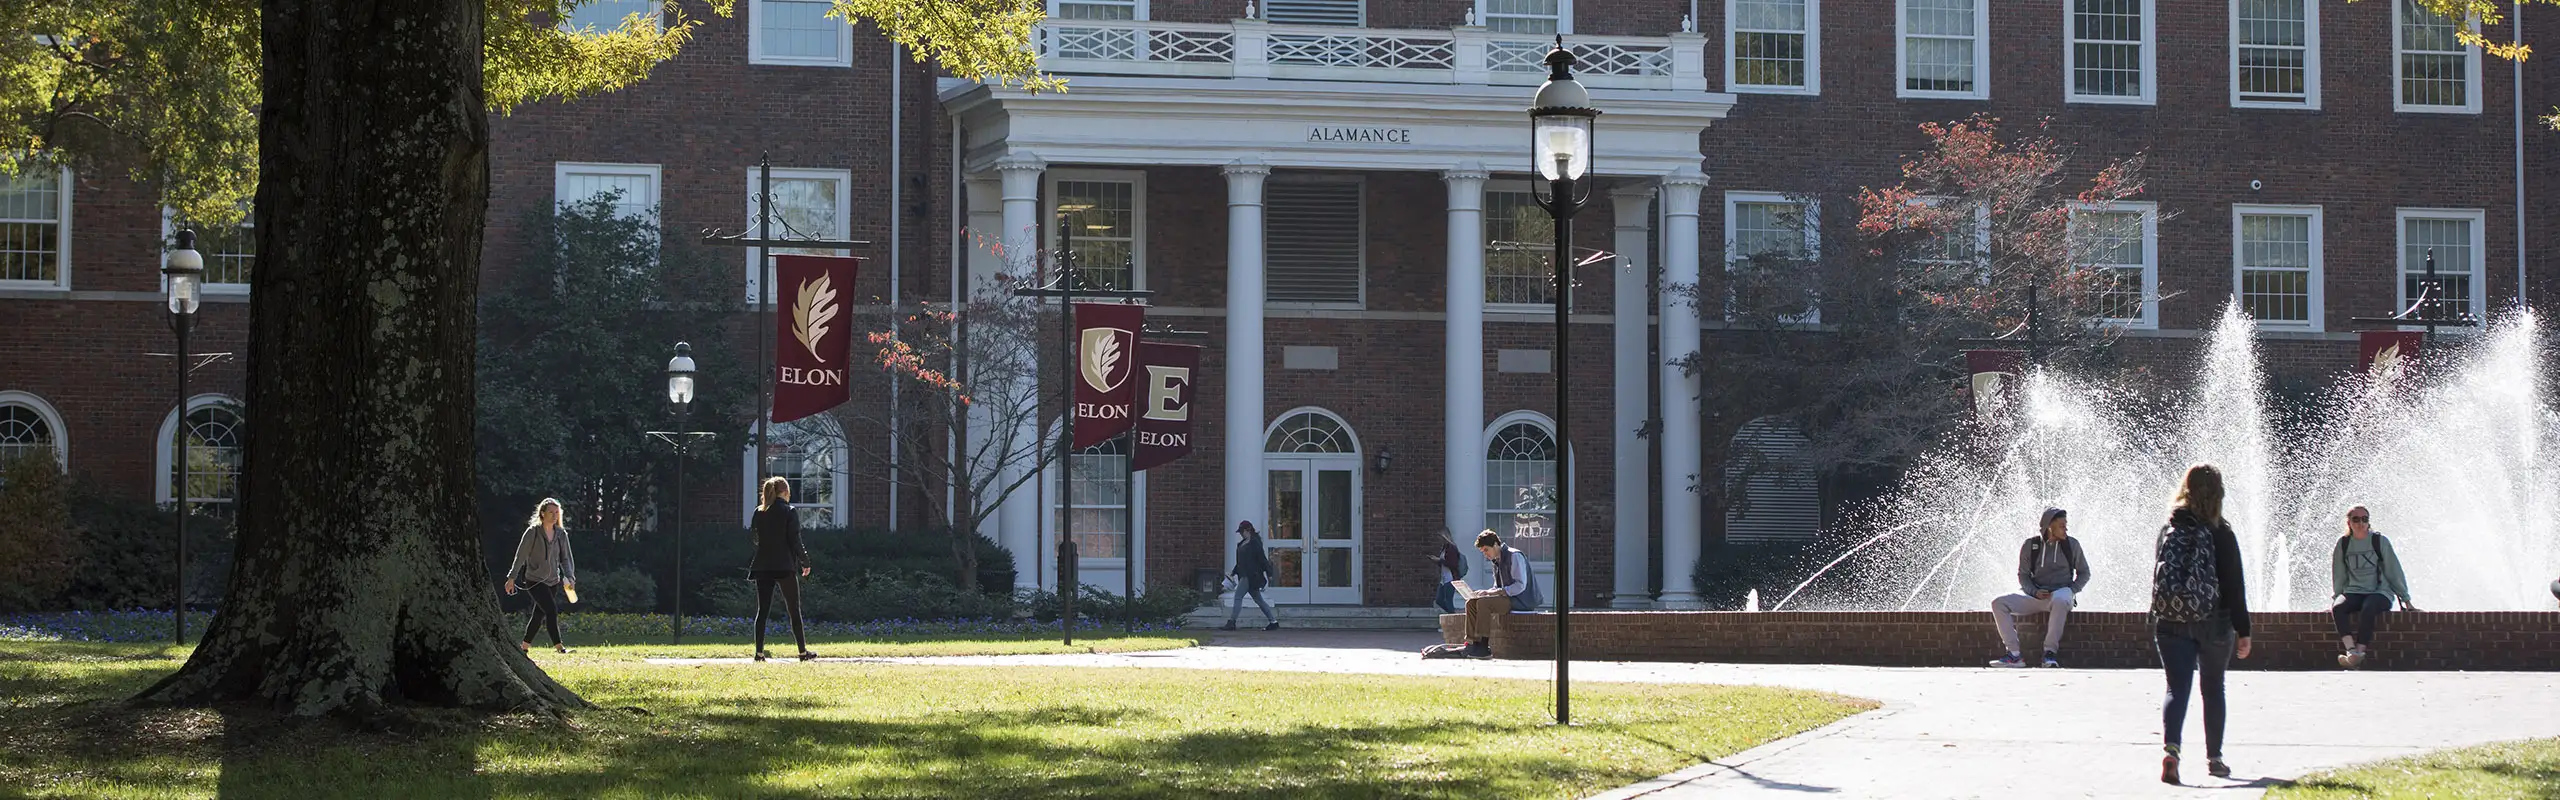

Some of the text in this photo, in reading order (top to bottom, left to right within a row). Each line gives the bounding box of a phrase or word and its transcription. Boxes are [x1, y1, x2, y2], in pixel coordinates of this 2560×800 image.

[1310, 127, 1410, 142] ALAMANCE
[780, 366, 842, 386] ELON
[1142, 365, 1190, 422] E
[1078, 402, 1130, 419] ELON
[1139, 431, 1188, 447] ELON
